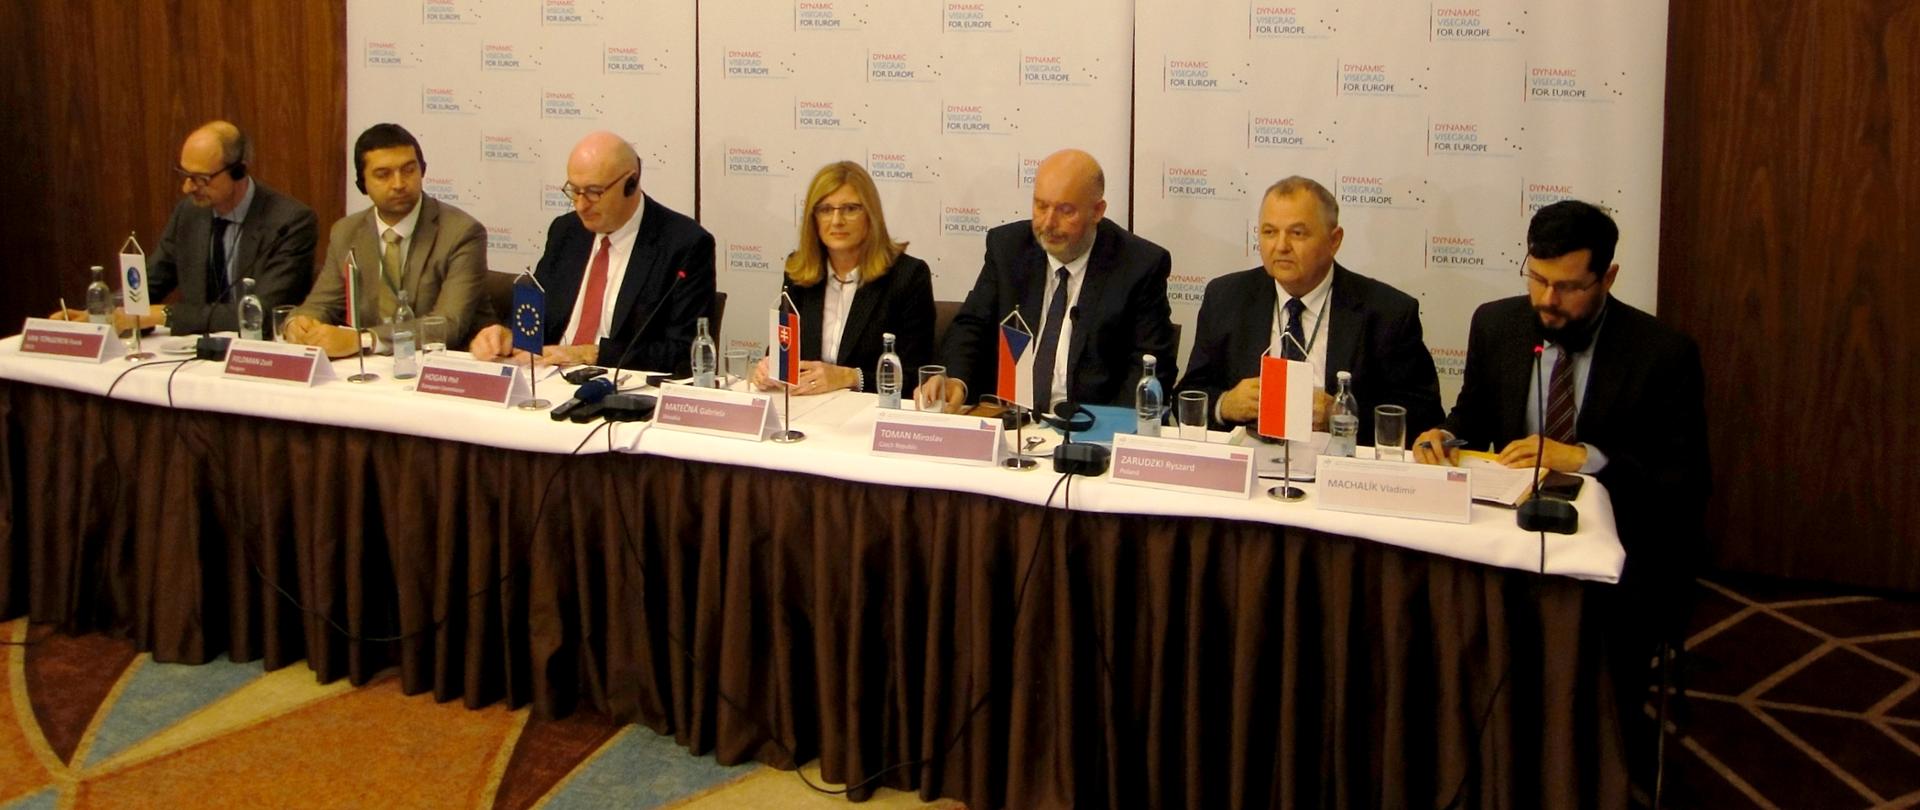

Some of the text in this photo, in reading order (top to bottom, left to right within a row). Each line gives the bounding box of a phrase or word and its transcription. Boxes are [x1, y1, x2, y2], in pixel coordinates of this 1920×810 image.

[1256, 7, 1296, 15] DYNAMIC
[1437, 9, 1480, 17] DYNAMIC
[815, 19, 840, 27] EUROPE
[1437, 18, 1480, 26] VISEGRAD
[1274, 26, 1305, 34] EUROPE
[1456, 29, 1490, 37] EUROPE
[1025, 56, 1060, 64] DYNAMIC
[1170, 61, 1208, 69] DYNAMIC
[1344, 64, 1384, 72] DYNAMIC
[1532, 68, 1576, 77] DYNAMIC
[1344, 73, 1384, 81] VISEGRAD
[1187, 79, 1217, 87] EUROPE
[1532, 78, 1576, 86] VISEGRAD
[1344, 83, 1395, 92] FOR EUROPE
[1532, 88, 1586, 97] FOR EUROPE
[815, 118, 840, 126] EUROPE
[1255, 118, 1294, 126] DYNAMIC
[1255, 126, 1294, 134] VISEGRAD
[1435, 123, 1477, 132] DYNAMIC
[1272, 136, 1303, 144] EUROPE
[1435, 133, 1478, 141] VISEGRAD
[730, 148, 762, 156] DYNAMIC
[1454, 144, 1487, 152] EUROPE
[872, 153, 905, 161] DYNAMIC
[1169, 168, 1207, 176] DYNAMIC
[1342, 176, 1382, 185] DYNAMIC
[1169, 186, 1216, 195] FOR EUROPE
[1342, 186, 1382, 194] VISEGRAD
[1530, 184, 1573, 194] DYNAMIC
[1360, 196, 1392, 204] EUROPE
[945, 207, 980, 215] DYNAMIC
[1432, 236, 1474, 245] DYNAMIC
[1432, 246, 1474, 255] VISEGRAD
[1432, 255, 1484, 265] FOR EUROPE
[744, 261, 769, 269] EUROPE
[1169, 274, 1207, 283] DYNAMIC
[1169, 284, 1205, 292] VISEGRAD
[1185, 293, 1204, 301] EURO
[1431, 347, 1466, 357] DYNAMI
[880, 429, 943, 442] TOMAN Miroslav
[1120, 455, 1195, 472] ZARUDZKI Ryszard
[1328, 479, 1378, 492] MACHALÍK
